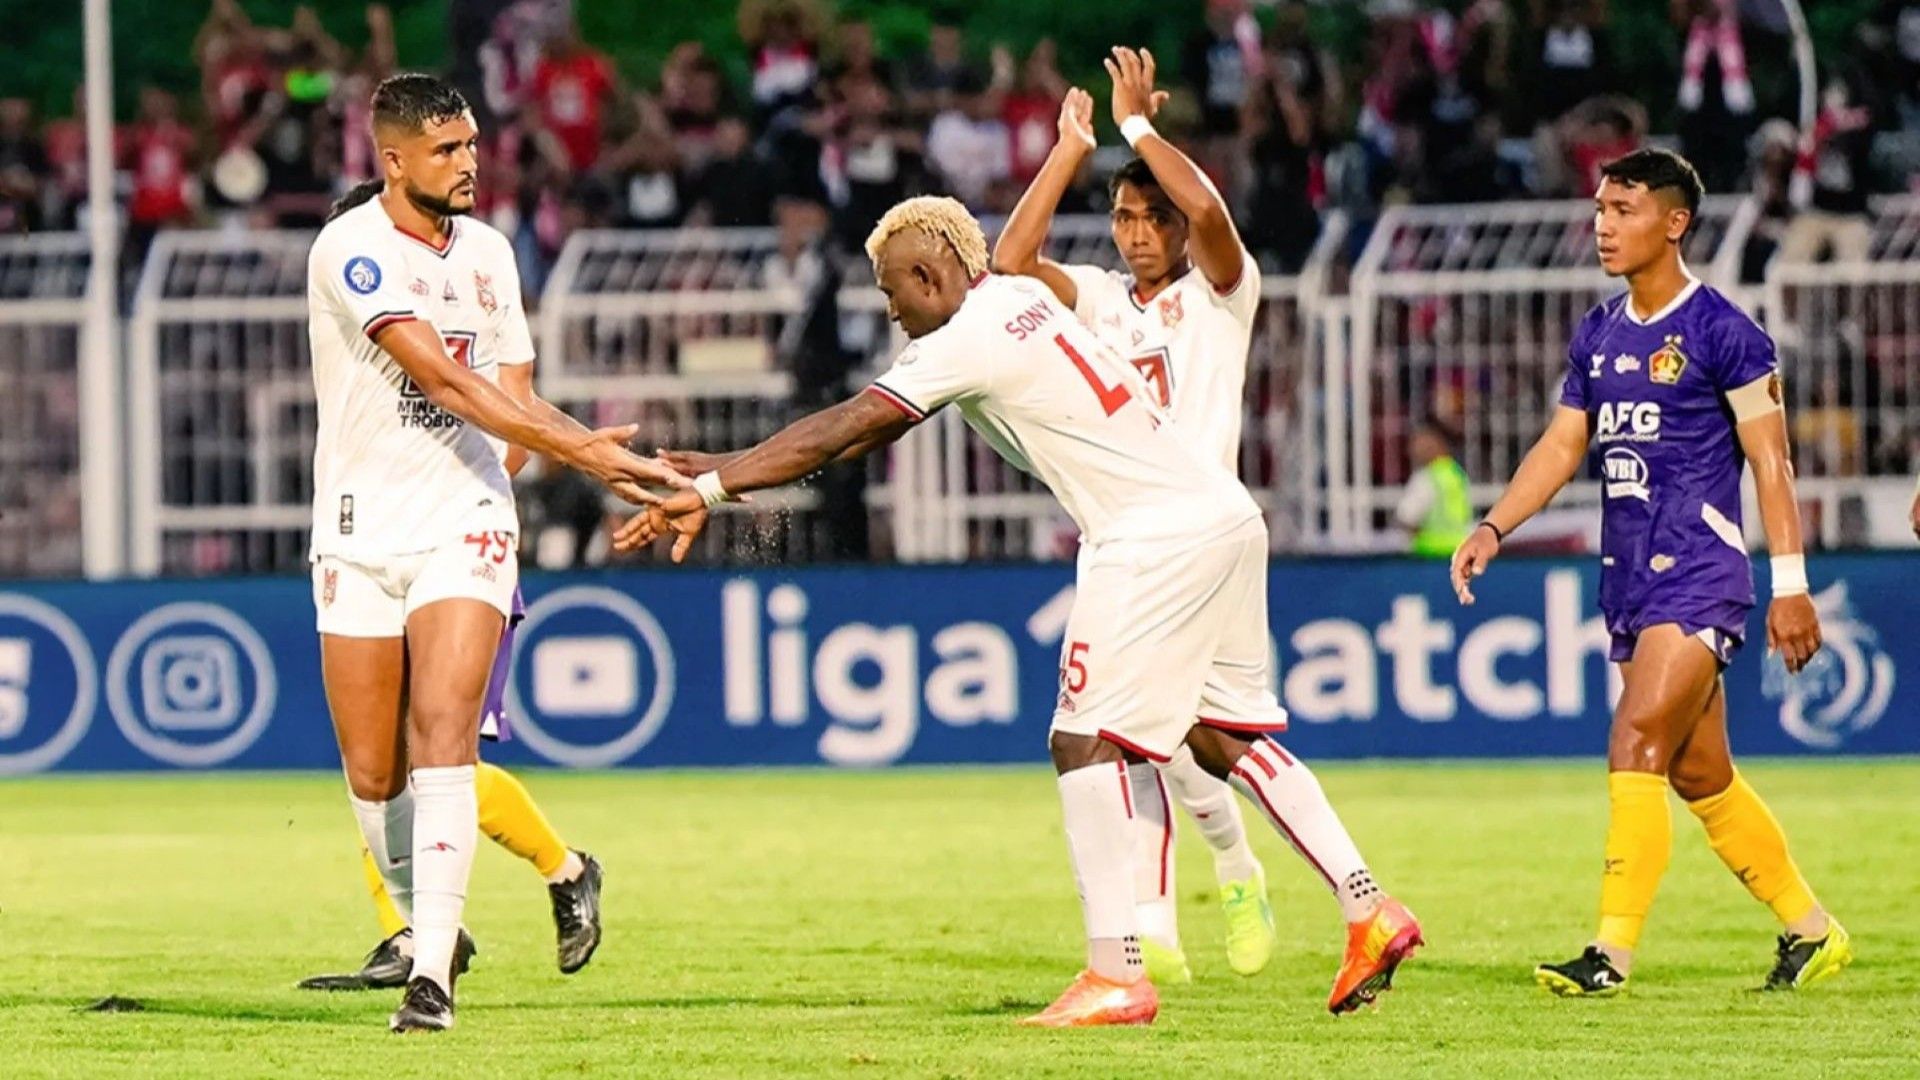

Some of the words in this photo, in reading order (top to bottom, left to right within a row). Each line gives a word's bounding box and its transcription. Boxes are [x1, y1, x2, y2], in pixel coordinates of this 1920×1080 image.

[1005, 298, 1054, 341] SONY
[398, 400, 444, 414] MINE
[1597, 402, 1661, 432] AFG
[464, 531, 508, 564] 49
[721, 577, 1074, 766] liga
[1267, 570, 1624, 722] atch
[1060, 641, 1090, 694] 5
